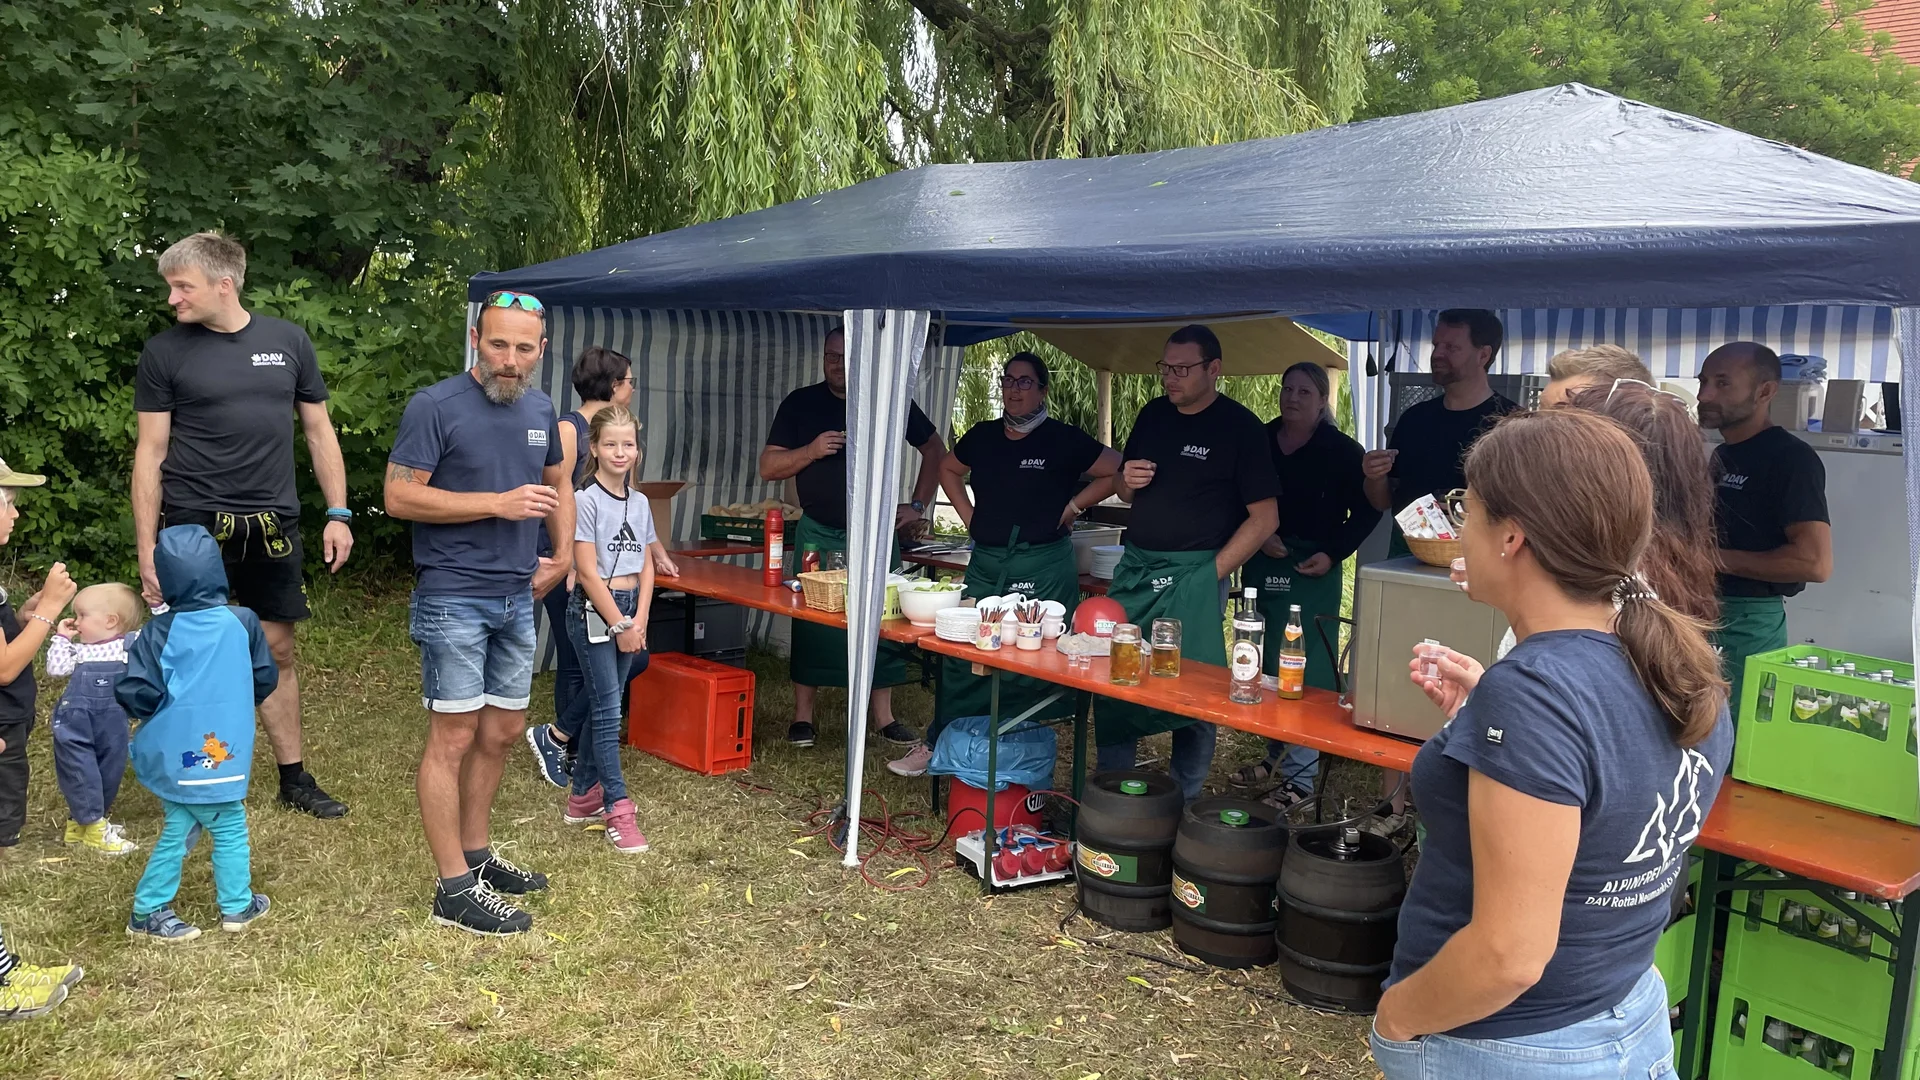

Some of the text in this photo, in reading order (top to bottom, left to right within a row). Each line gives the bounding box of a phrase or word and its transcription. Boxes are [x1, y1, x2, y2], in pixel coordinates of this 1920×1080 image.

[261, 353, 283, 361] DAV
[1190, 445, 1210, 456] DAV
[1728, 473, 1749, 485] DAV
[607, 540, 642, 553] adidas
[1272, 576, 1291, 584] DAV
[1585, 896, 1611, 907] DAV
[1611, 893, 1638, 908] Rottal
